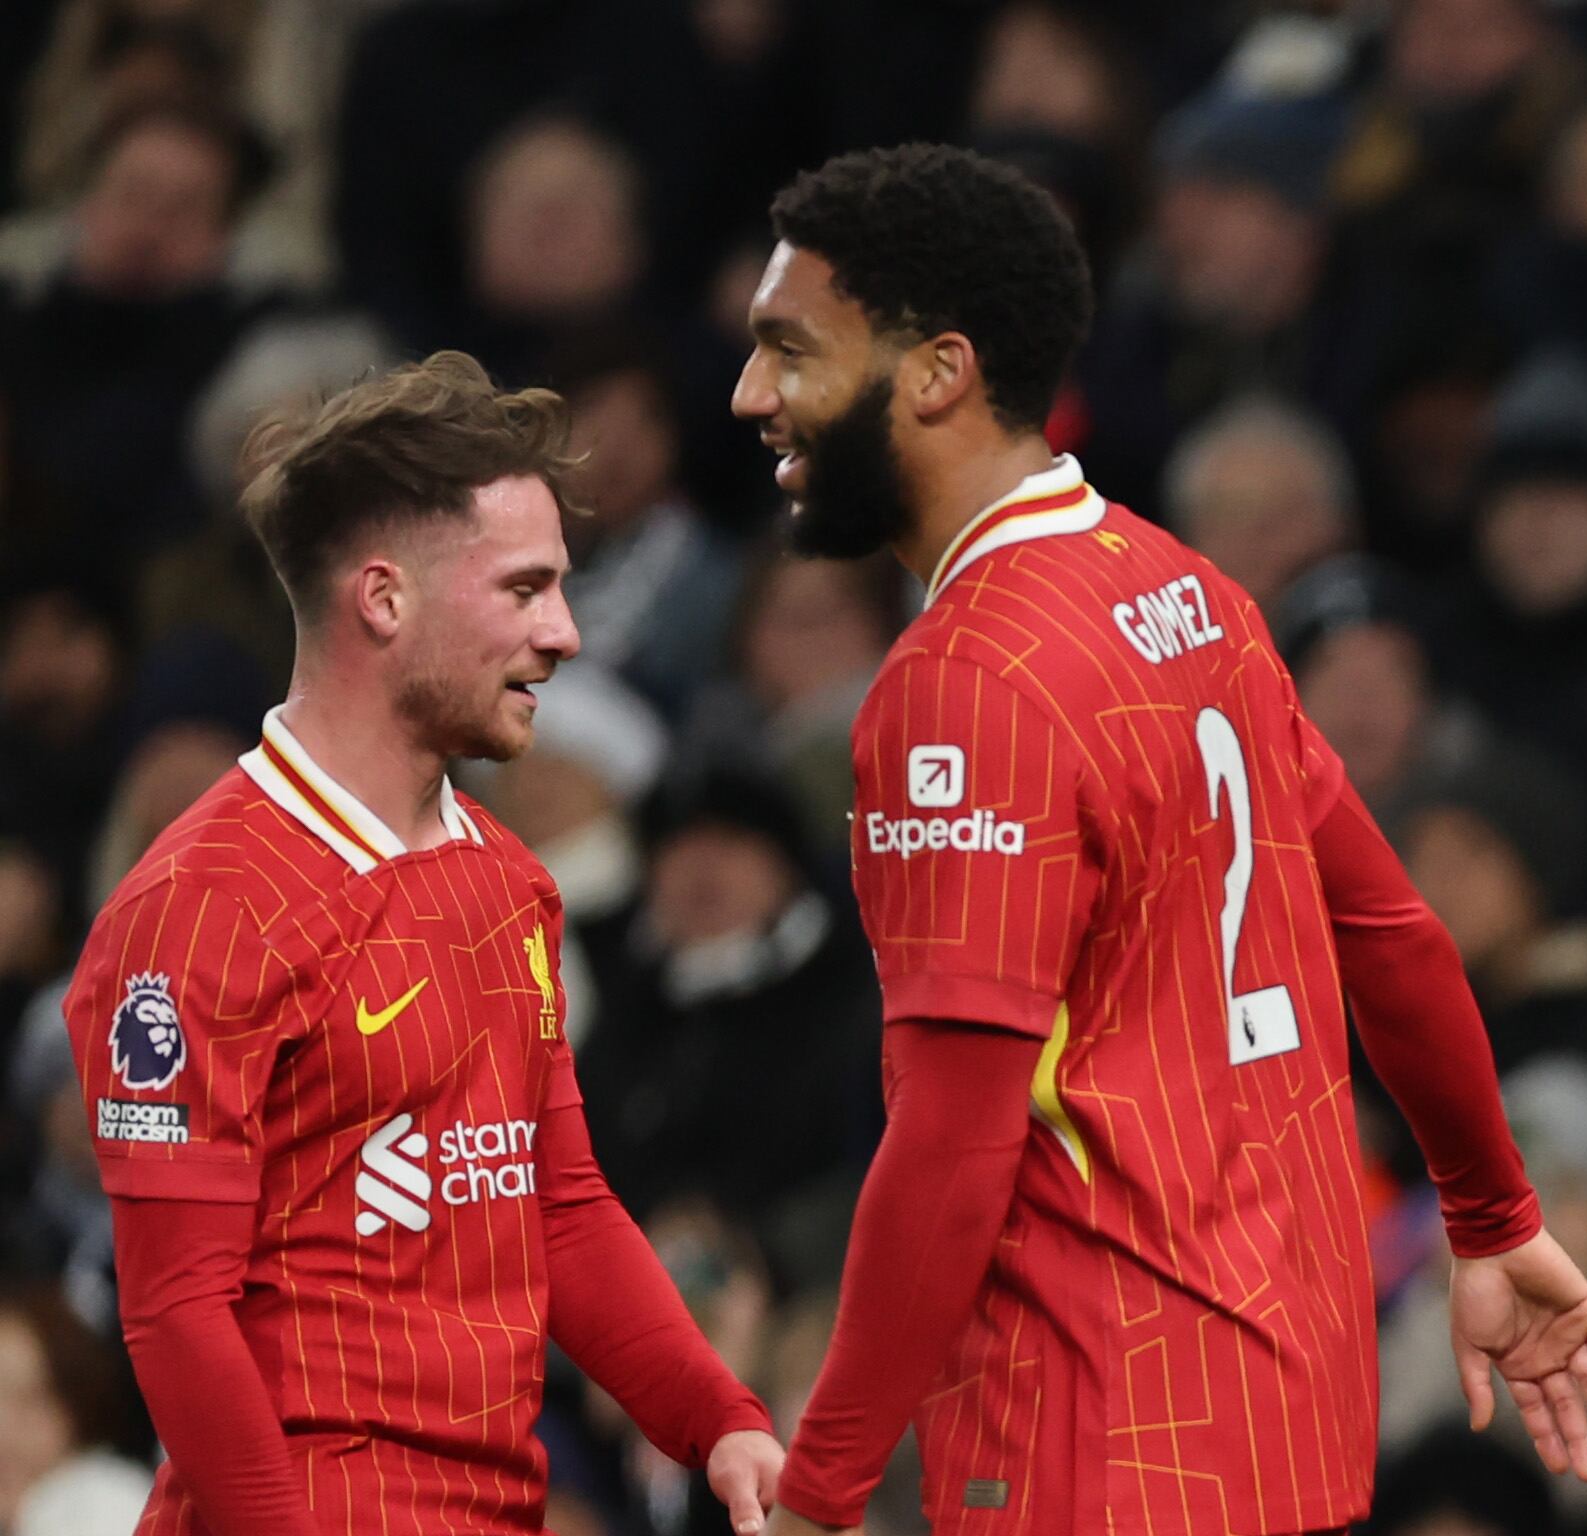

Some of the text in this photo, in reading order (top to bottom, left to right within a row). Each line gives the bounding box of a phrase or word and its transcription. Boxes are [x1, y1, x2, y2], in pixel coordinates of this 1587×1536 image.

[1112, 574, 1224, 665] GOMEZ
[866, 809, 1025, 861] Expedia
[1195, 706, 1301, 1067] 2
[97, 1098, 179, 1125] No room
[97, 1118, 189, 1144] for racism
